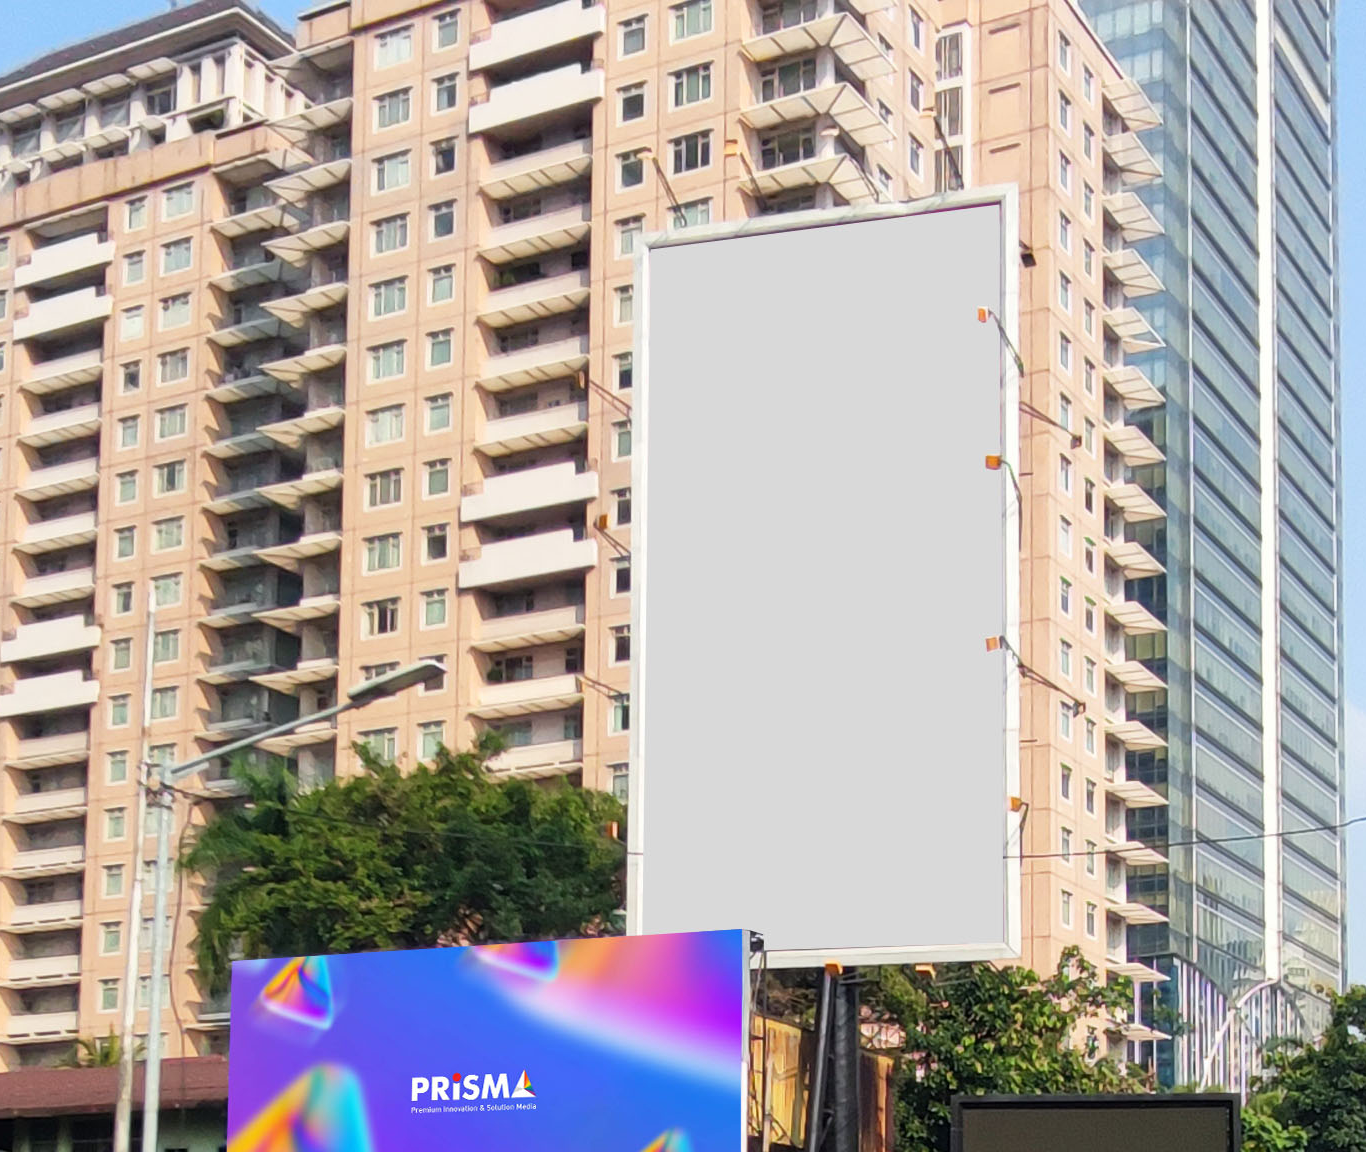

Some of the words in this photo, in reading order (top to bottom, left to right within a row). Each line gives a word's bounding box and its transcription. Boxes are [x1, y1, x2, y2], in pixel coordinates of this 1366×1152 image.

[411, 1106, 442, 1114] Premium
[443, 1104, 478, 1113] Innovation
[486, 1103, 515, 1112] Solution
[516, 1102, 537, 1110] Media
